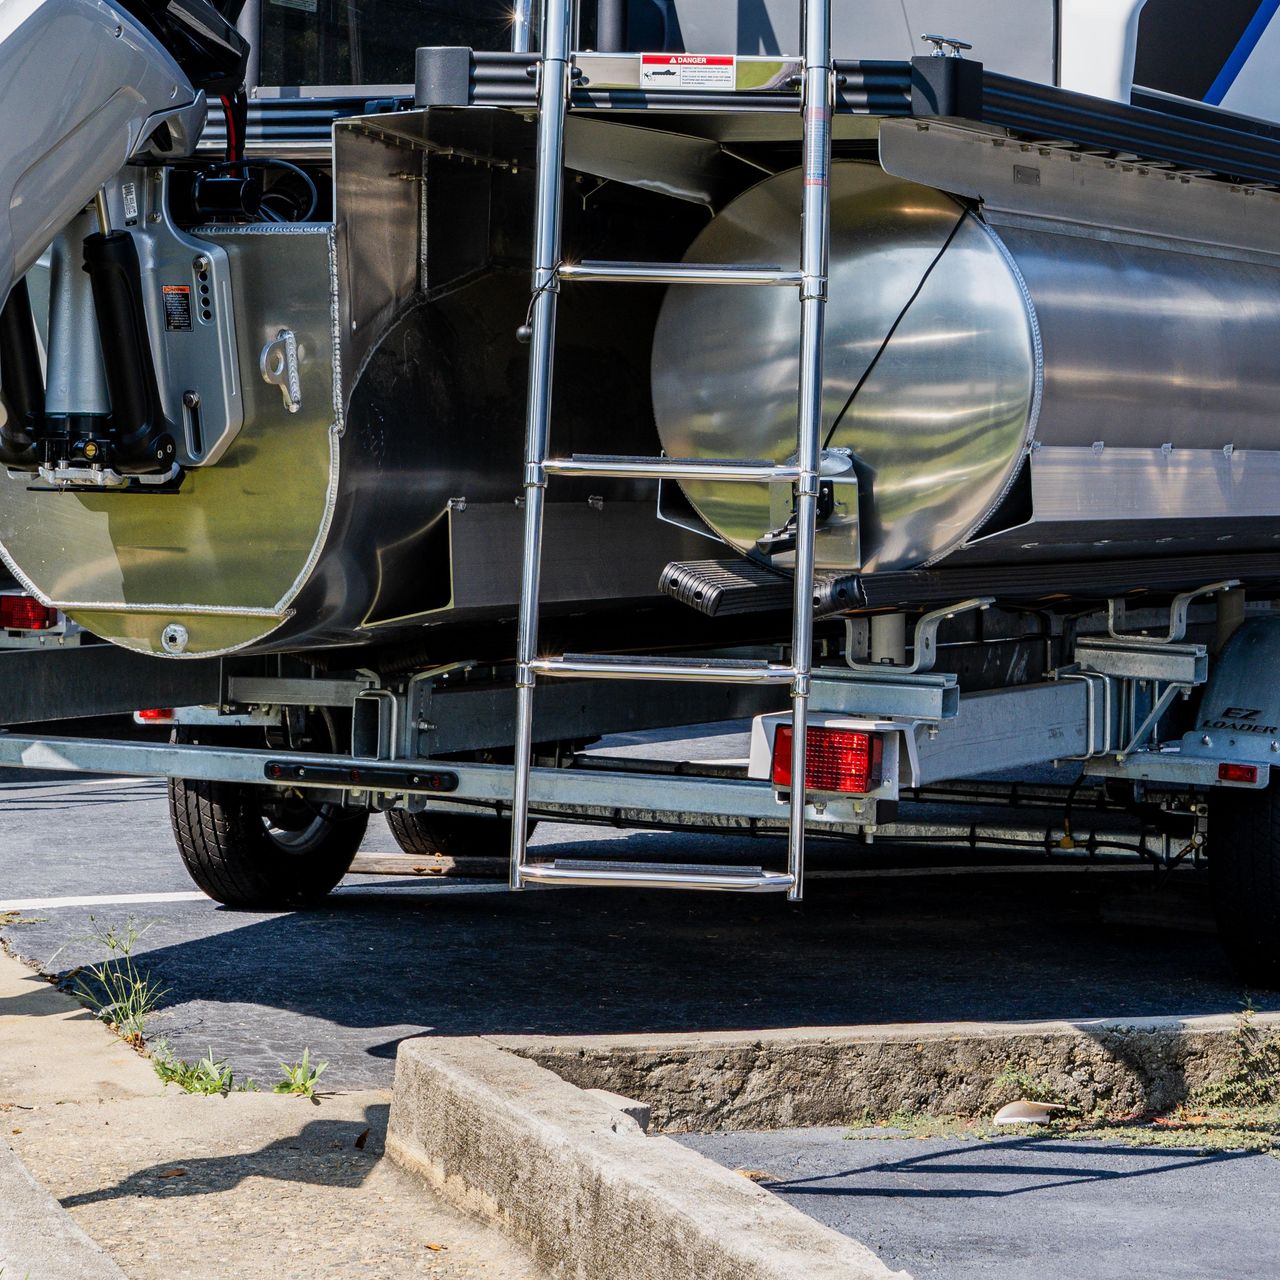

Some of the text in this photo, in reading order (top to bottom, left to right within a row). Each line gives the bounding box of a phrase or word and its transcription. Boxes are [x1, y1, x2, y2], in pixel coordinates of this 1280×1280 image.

[677, 56, 707, 64] DANGER
[1222, 707, 1262, 721] EZ
[1202, 720, 1278, 735] LOADER
